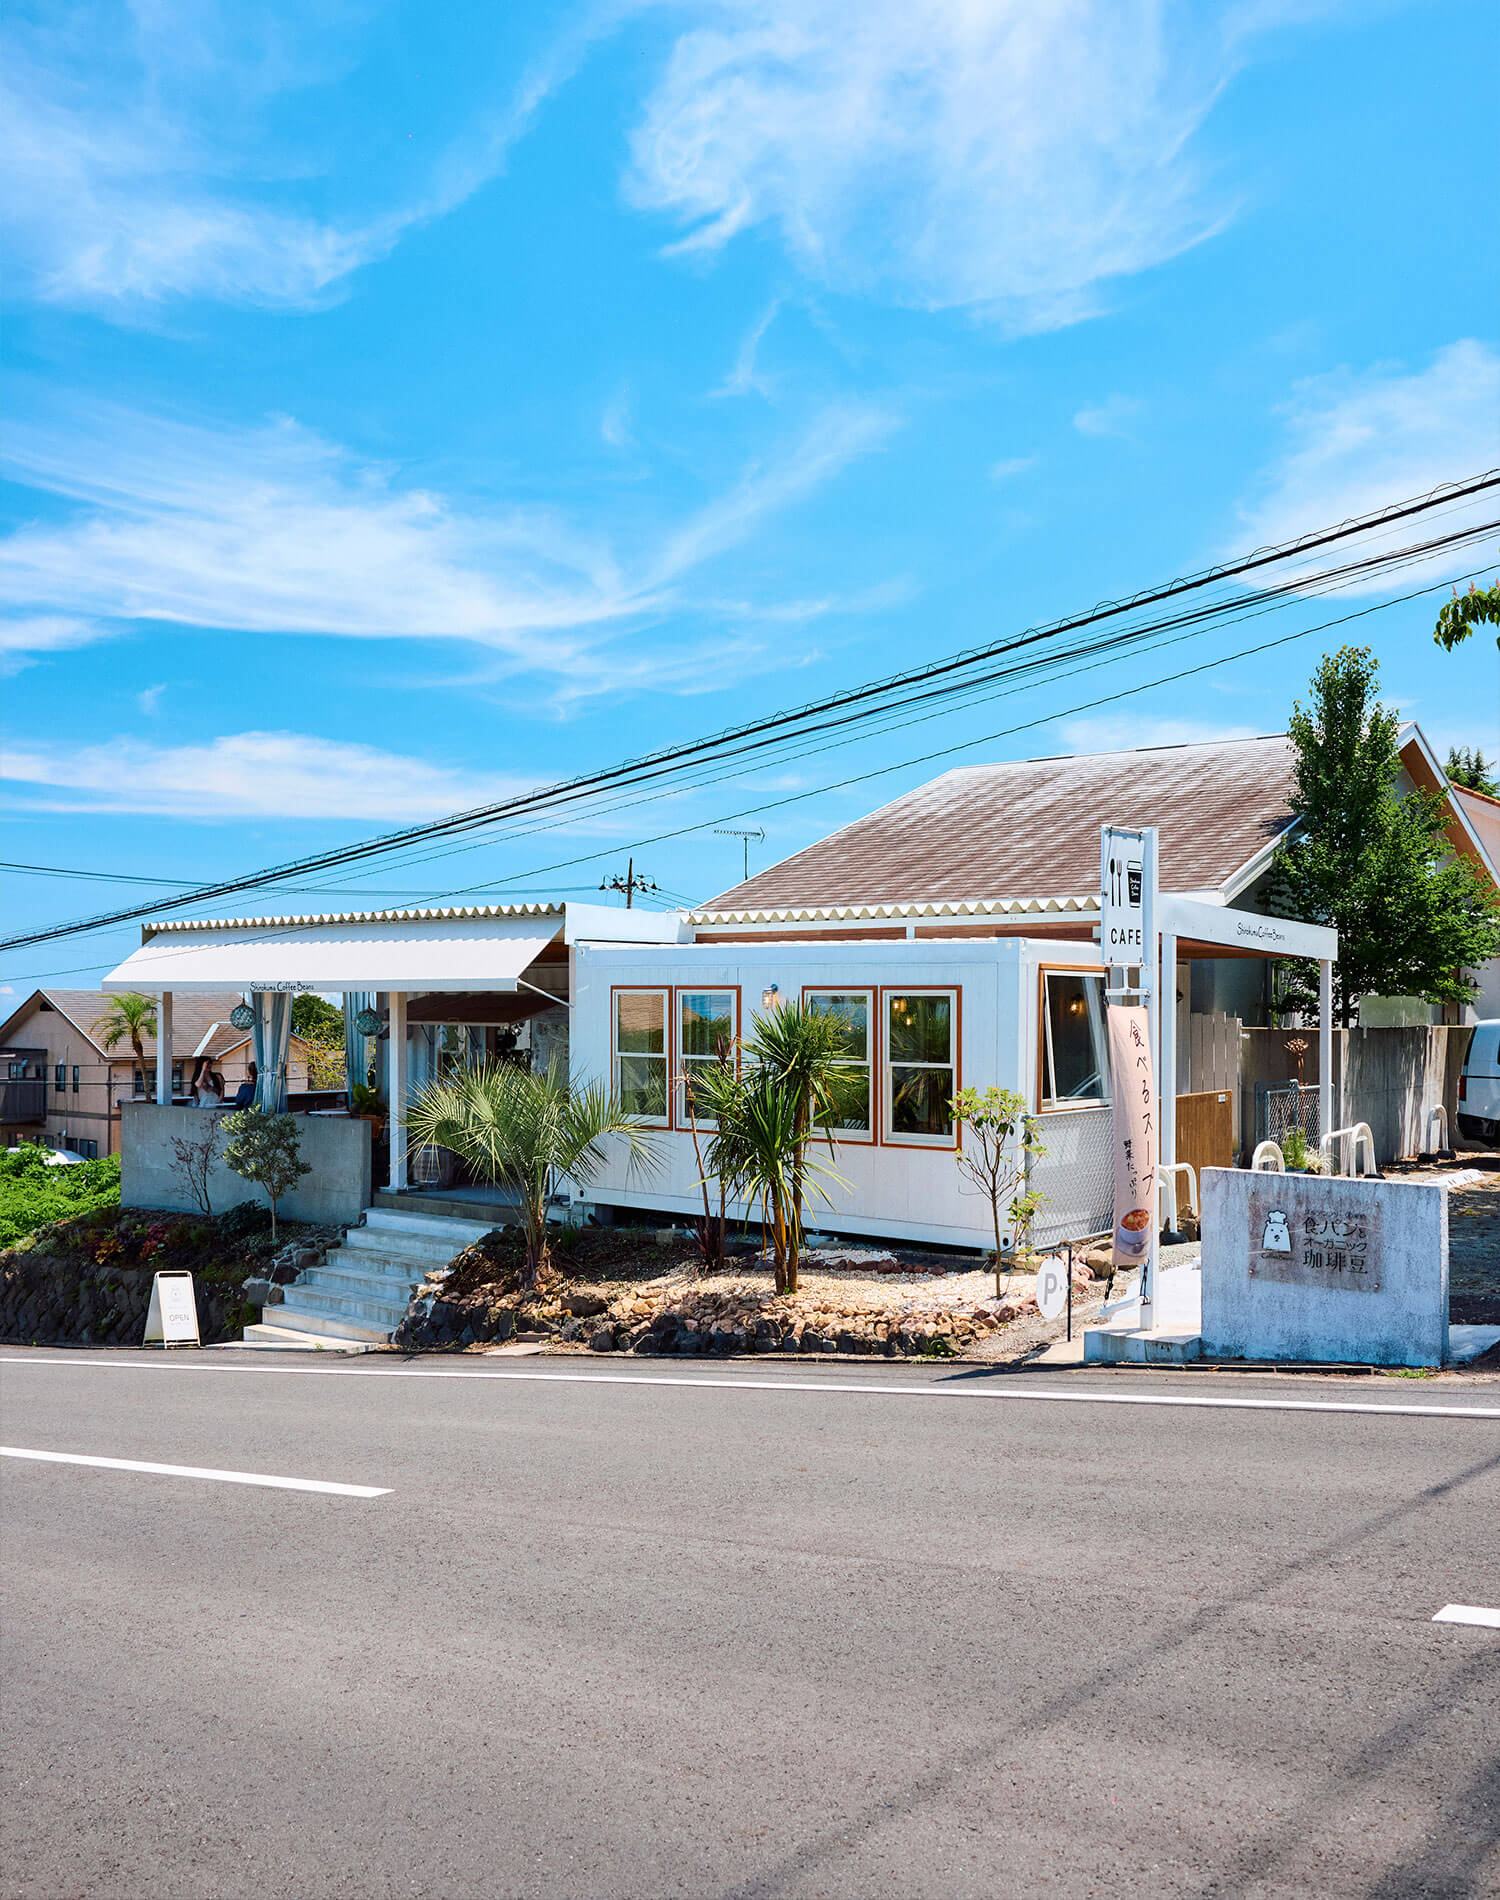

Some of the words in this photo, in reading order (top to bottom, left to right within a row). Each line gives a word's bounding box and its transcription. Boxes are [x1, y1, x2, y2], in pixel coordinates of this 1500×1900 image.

[1110, 928, 1141, 945] CAFE
[277, 981, 296, 992] Coffee
[297, 981, 314, 991] Beans
[1129, 1019, 1154, 1196] 食べるスープ
[1303, 1216, 1367, 1239] 食パンと
[1303, 1238, 1368, 1253] オーガニック
[1303, 1249, 1368, 1275] 珈琲豆
[1044, 1273, 1057, 1305] P
[169, 1314, 190, 1322] OPEN
